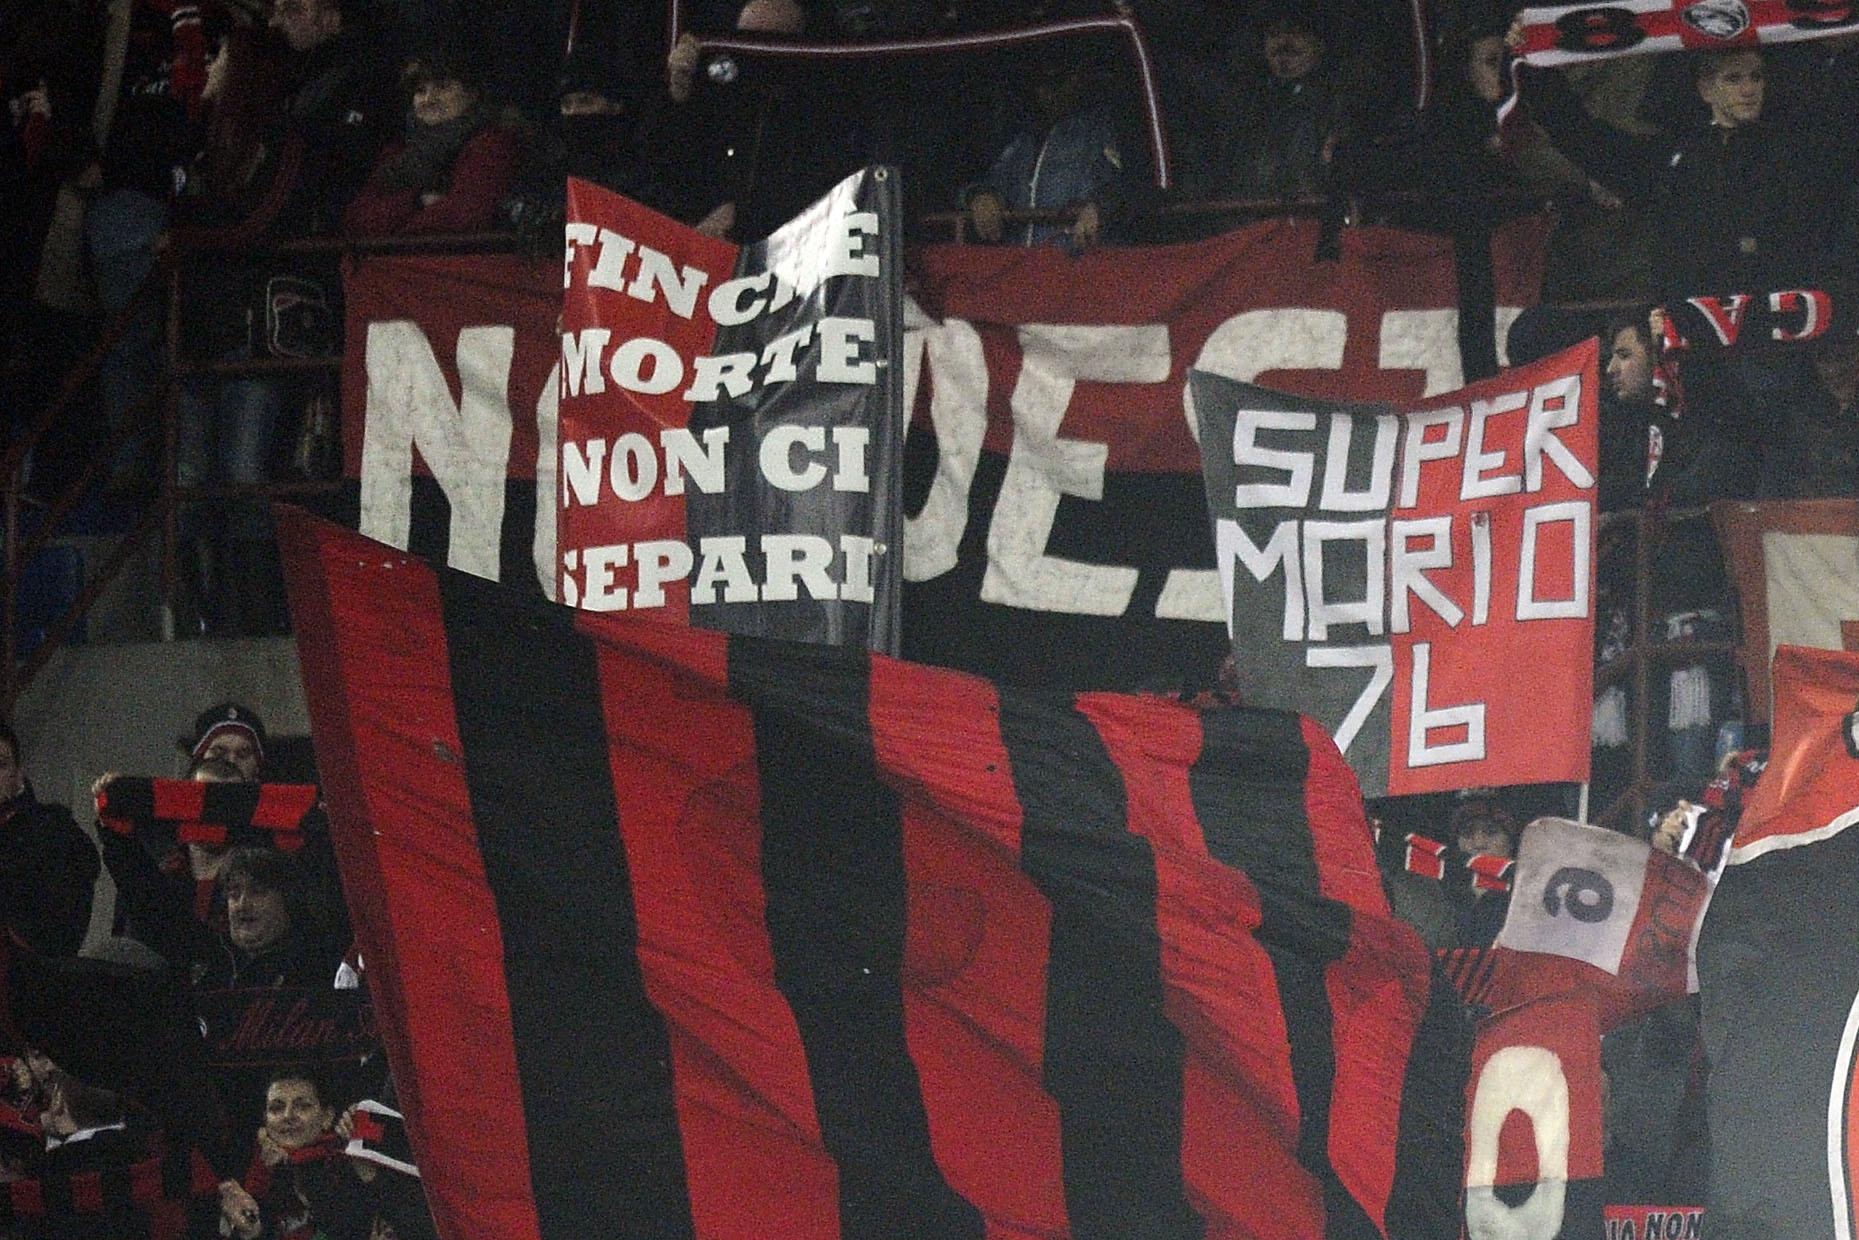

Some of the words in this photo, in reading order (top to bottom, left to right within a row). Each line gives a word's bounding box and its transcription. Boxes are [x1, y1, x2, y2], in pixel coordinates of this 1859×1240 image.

[562, 318, 877, 401] MORTE
[563, 427, 730, 507] NON
[759, 424, 870, 493] CI
[1232, 372, 1595, 514] SUPER
